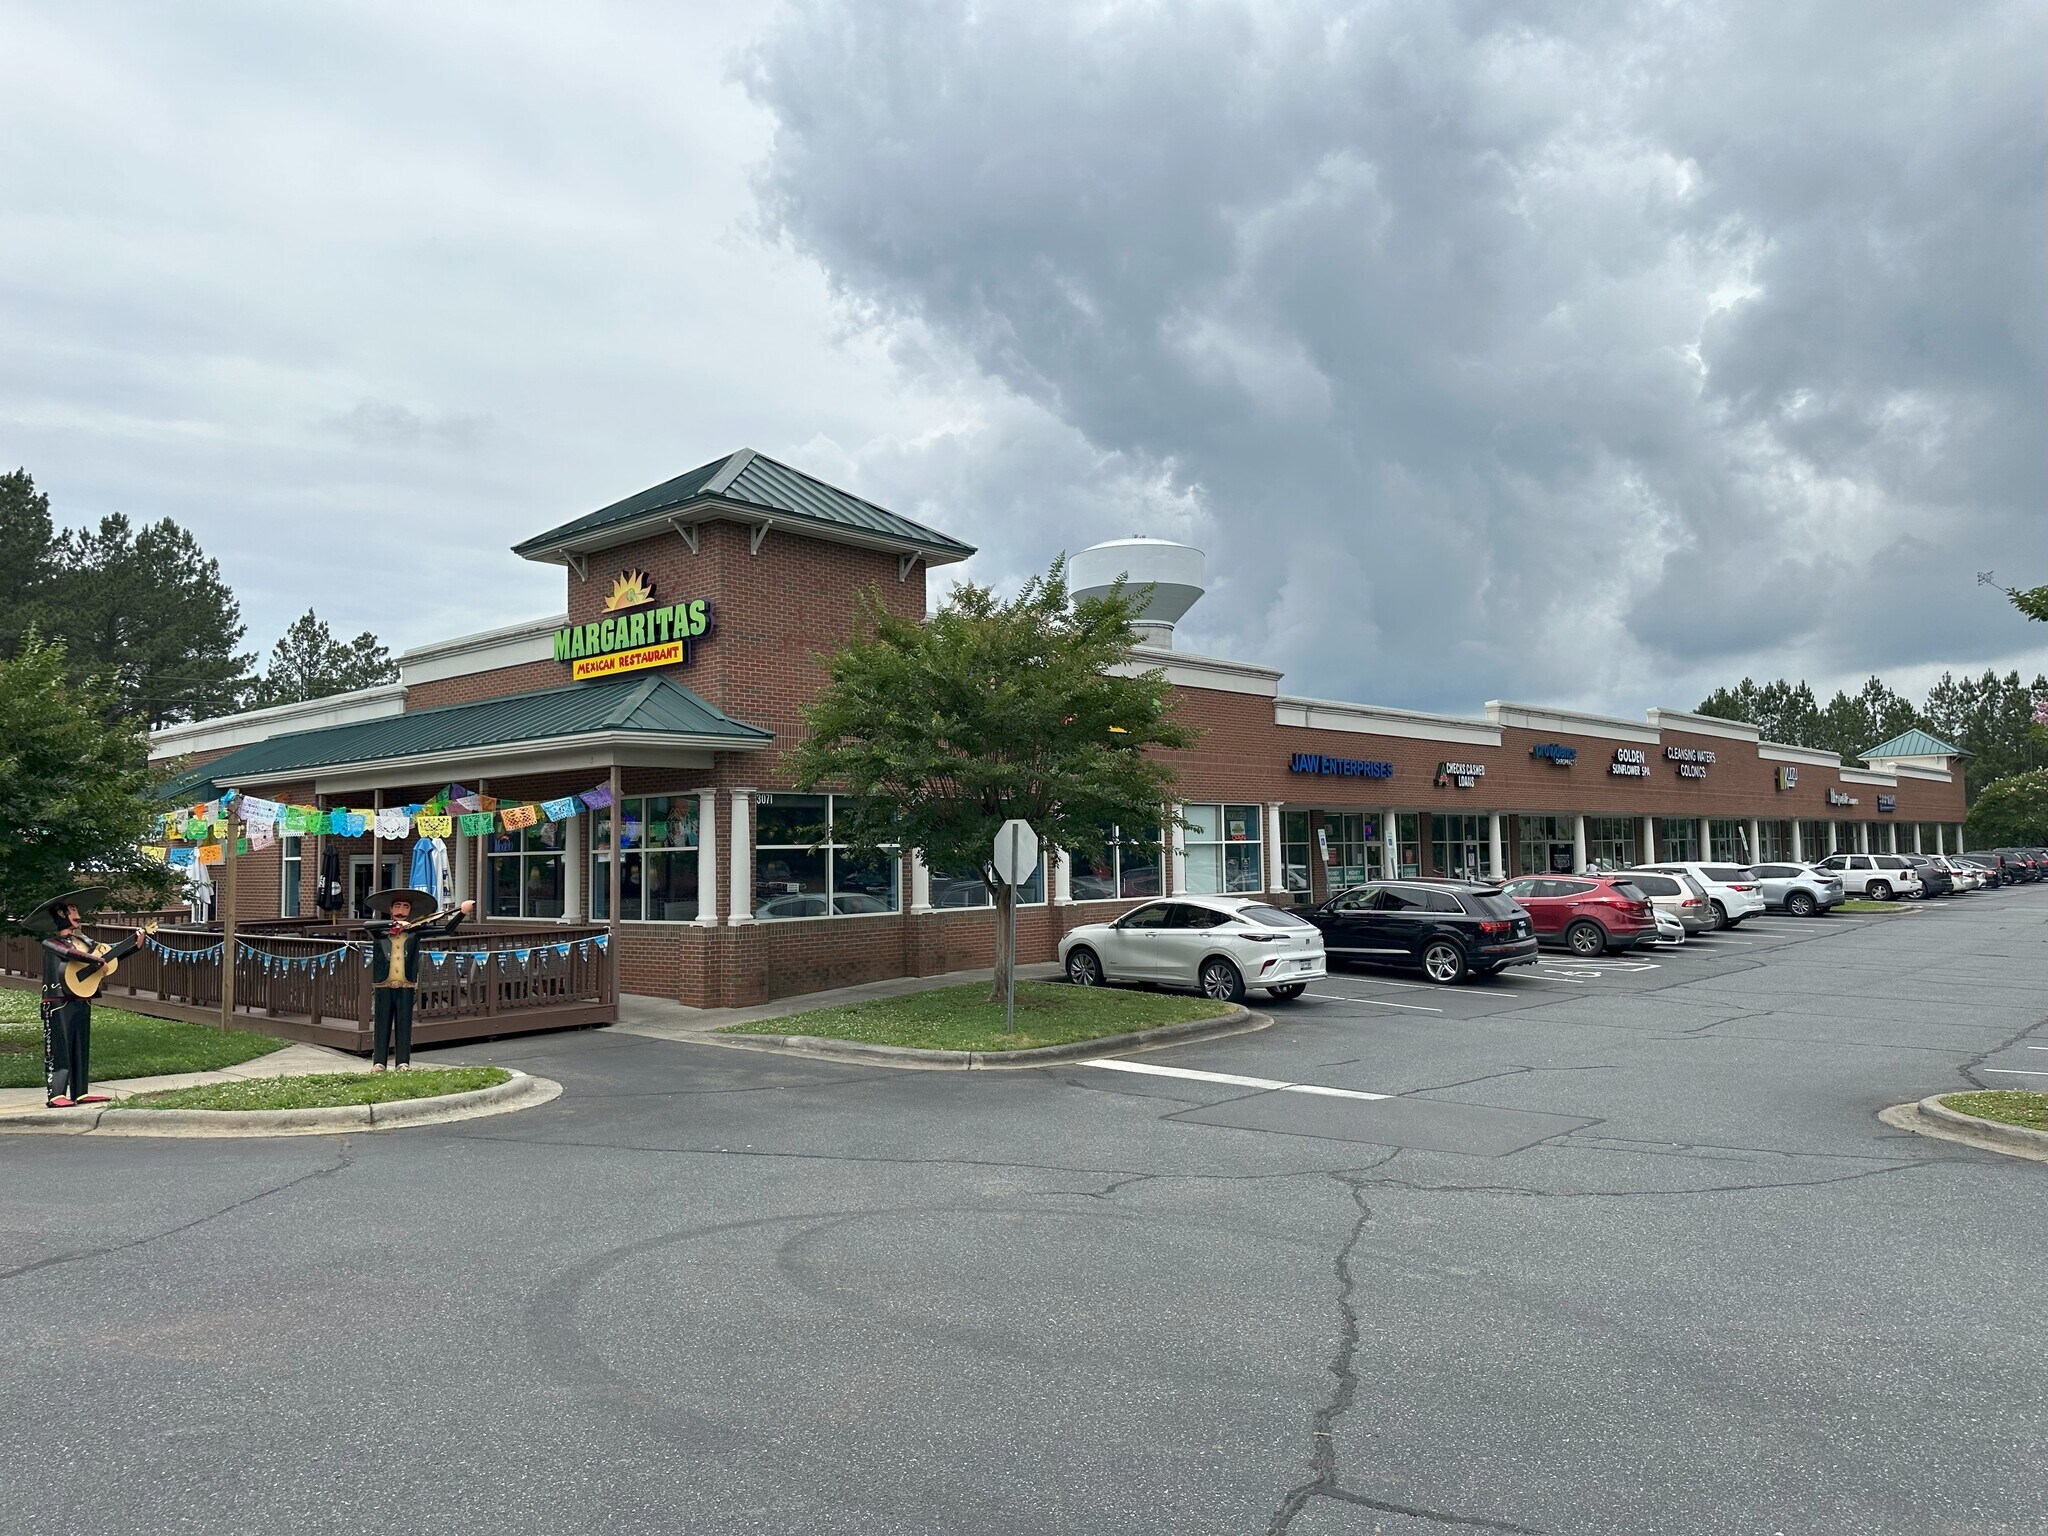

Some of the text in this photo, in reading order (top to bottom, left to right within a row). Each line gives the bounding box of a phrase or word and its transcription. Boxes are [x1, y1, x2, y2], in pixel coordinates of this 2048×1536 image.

[554, 600, 707, 661] MARGARITAS
[577, 646, 679, 675] MEXICAN RESTAURANT
[1617, 748, 1645, 764] GOLDEN
[1667, 746, 1716, 763] CLEANSING WATERS
[1292, 753, 1319, 773] JAW
[1446, 762, 1485, 776] CHECKS CASHED
[1612, 763, 1651, 777] SUNFLOWER SPA
[1680, 764, 1707, 778] COLONICS
[1458, 775, 1475, 787] LOANS
[756, 794, 773, 805] 3071
